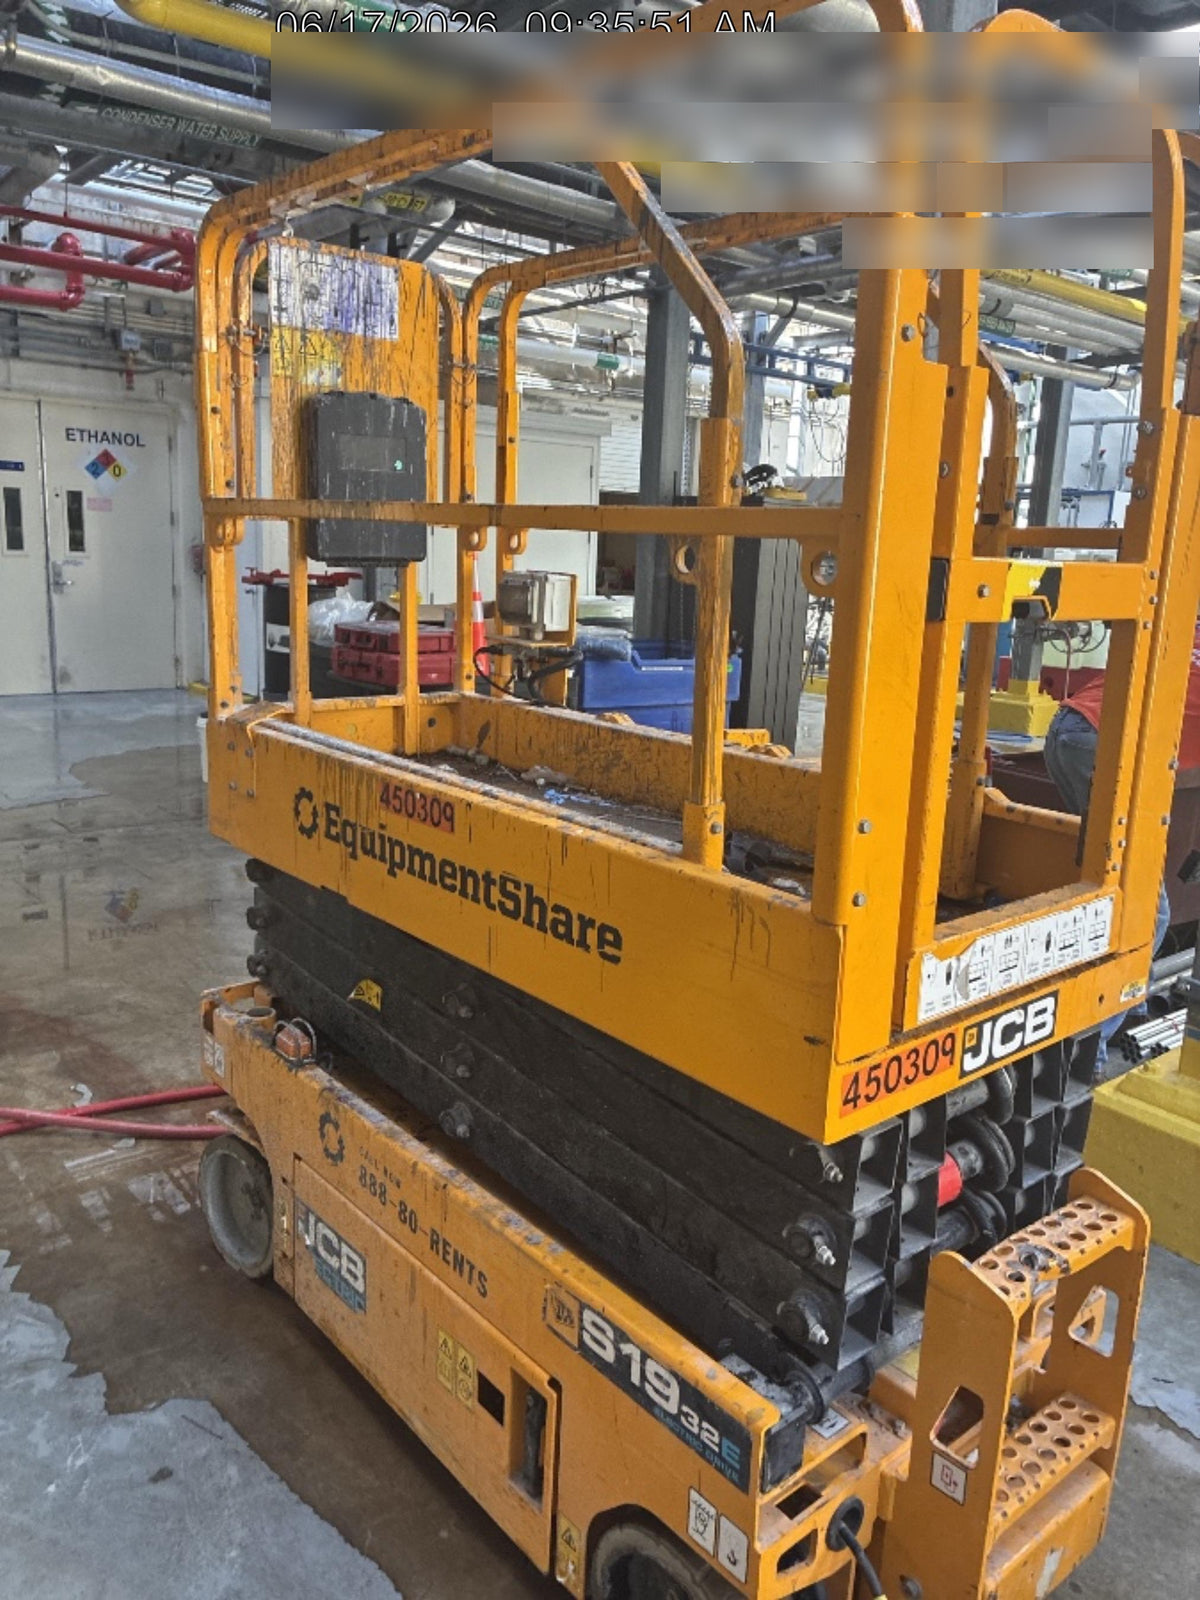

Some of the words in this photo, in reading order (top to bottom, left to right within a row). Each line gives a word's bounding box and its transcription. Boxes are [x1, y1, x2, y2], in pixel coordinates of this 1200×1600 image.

[102, 107, 176, 130] CONDENSER
[175, 117, 218, 138] WATER
[217, 127, 261, 147] SUPPLY
[65, 427, 147, 447] ETHANOL
[112, 463, 122, 477] 0
[379, 782, 455, 833] 450309
[324, 802, 623, 965] EquipmentShare
[842, 1032, 956, 1109] 450309
[963, 996, 1056, 1072] JCB
[297, 1208, 366, 1294] JCB
[358, 1164, 488, 1299] 888-80-RENTS
